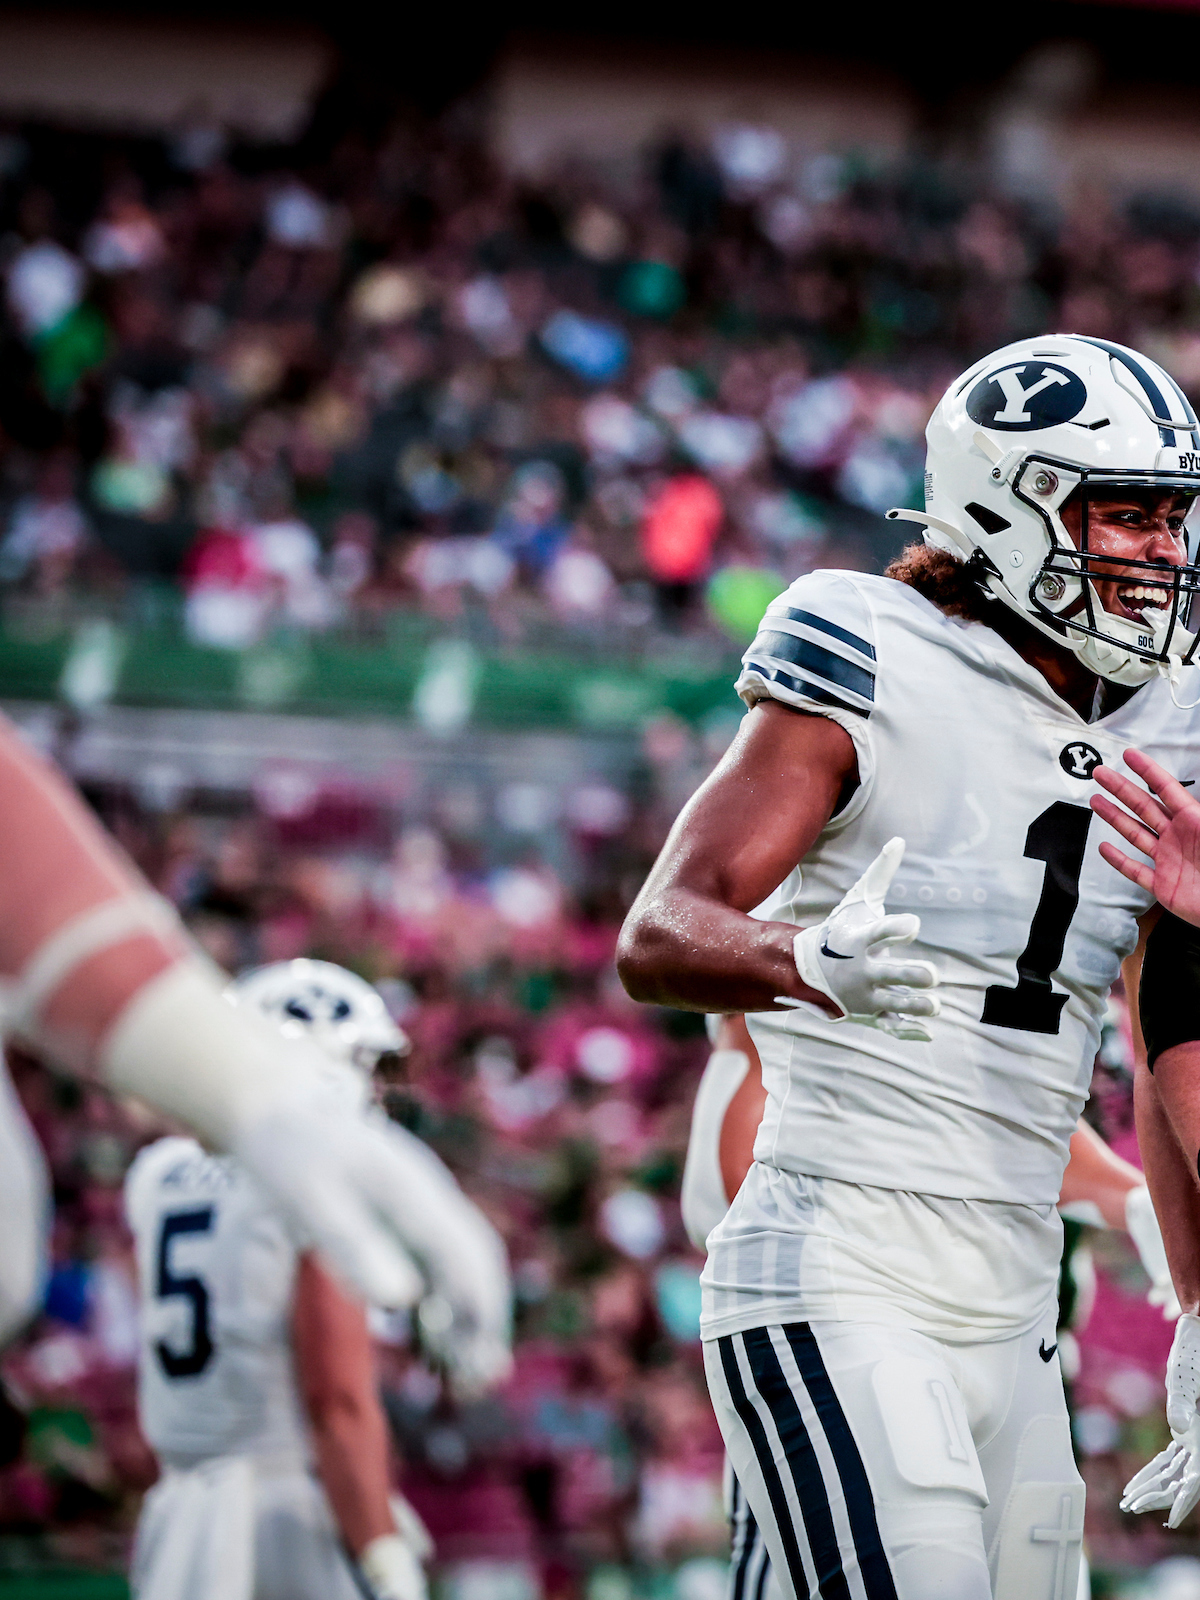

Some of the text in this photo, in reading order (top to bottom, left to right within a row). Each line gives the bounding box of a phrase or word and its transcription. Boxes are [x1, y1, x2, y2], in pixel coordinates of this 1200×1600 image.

[988, 366, 1071, 422] Y
[980, 801, 1093, 1035] 1
[157, 1207, 214, 1377] 5
